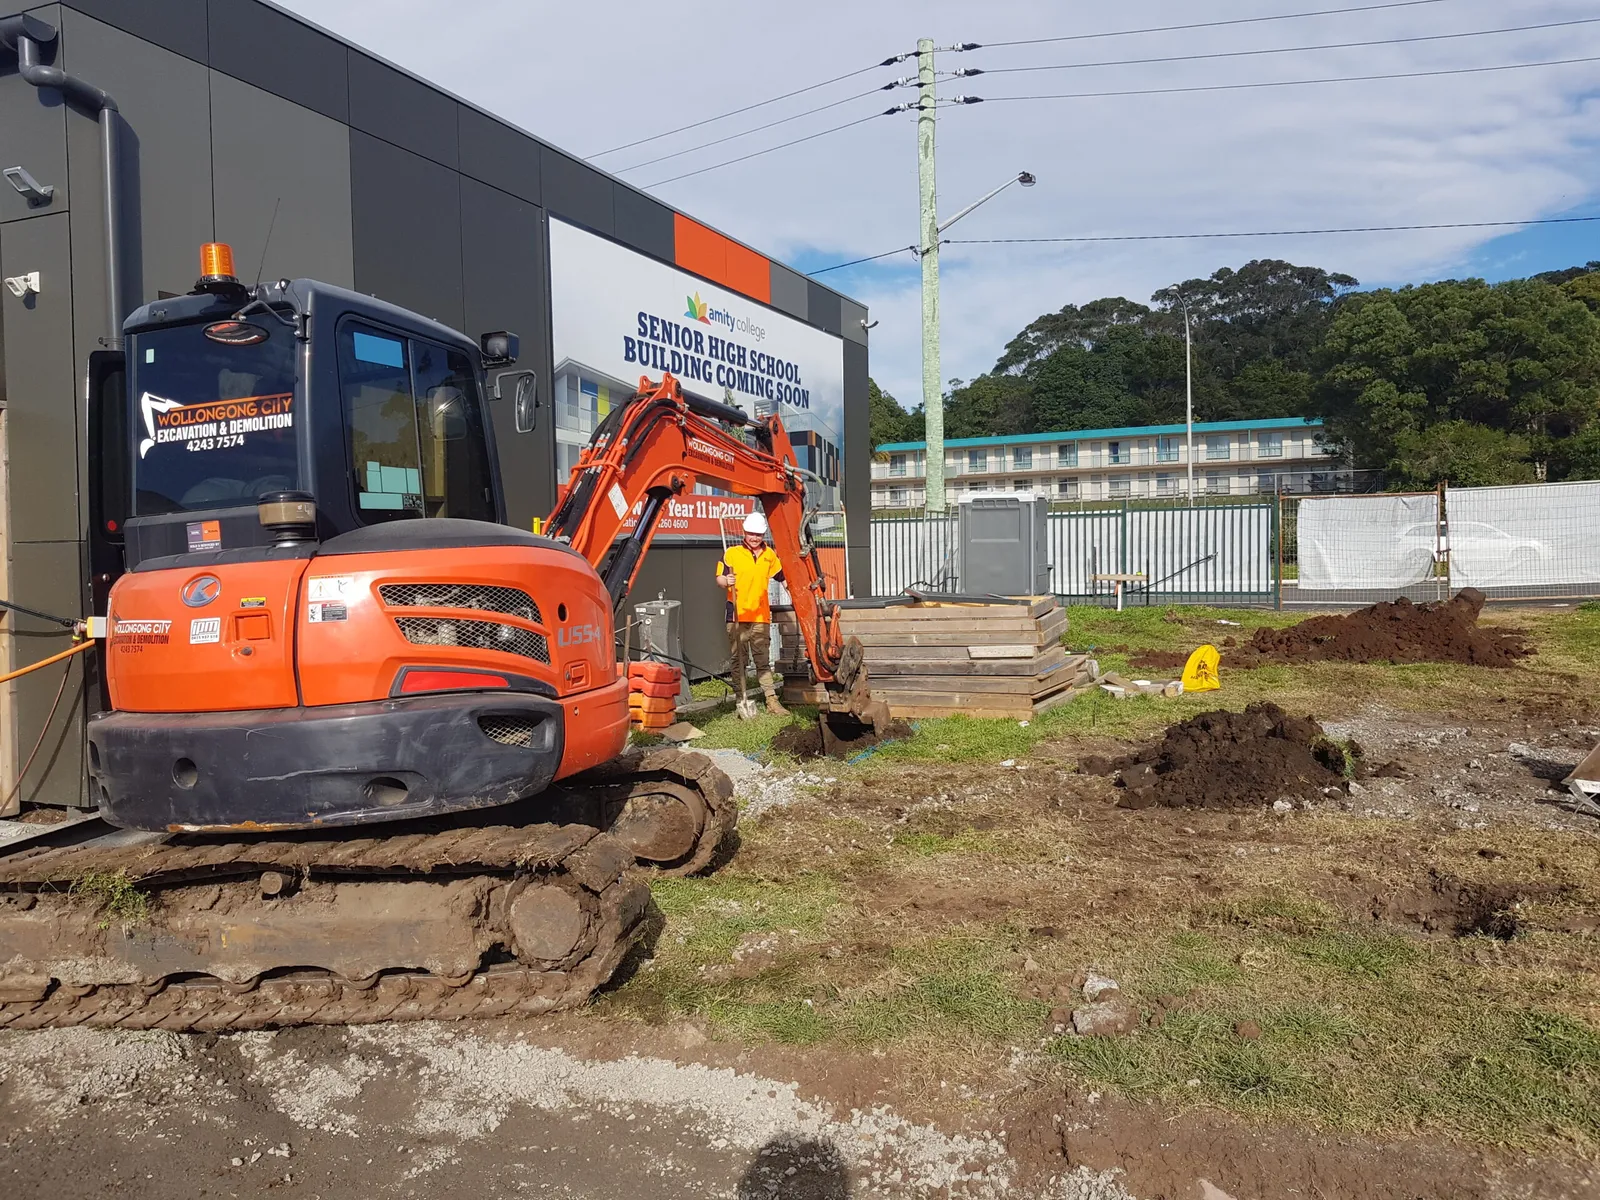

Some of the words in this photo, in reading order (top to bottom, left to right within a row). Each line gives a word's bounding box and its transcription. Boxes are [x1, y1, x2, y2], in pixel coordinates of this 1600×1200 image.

[708, 307, 735, 332] amity
[736, 317, 766, 342] college
[637, 311, 704, 355] SENIOR
[708, 335, 747, 368] HIGH
[750, 350, 801, 385] SCHOOL
[623, 336, 712, 383] BUILDING
[716, 364, 774, 400] COMING
[776, 382, 809, 409] SOON
[158, 402, 258, 427] WOLLONGONG
[261, 397, 292, 414] CITY
[157, 422, 216, 443] EXCAVATION
[219, 421, 228, 435] &
[230, 413, 292, 433] DEMOLITION
[186, 439, 214, 452] 4243
[216, 435, 244, 449] 7574
[658, 518, 672, 528] 260
[673, 519, 689, 529] 4600
[668, 499, 694, 517] Year
[696, 501, 707, 518] 11
[708, 501, 720, 518] in
[721, 502, 746, 519] 2021
[114, 623, 152, 634] WOLLONGONG
[153, 621, 171, 634] CITY
